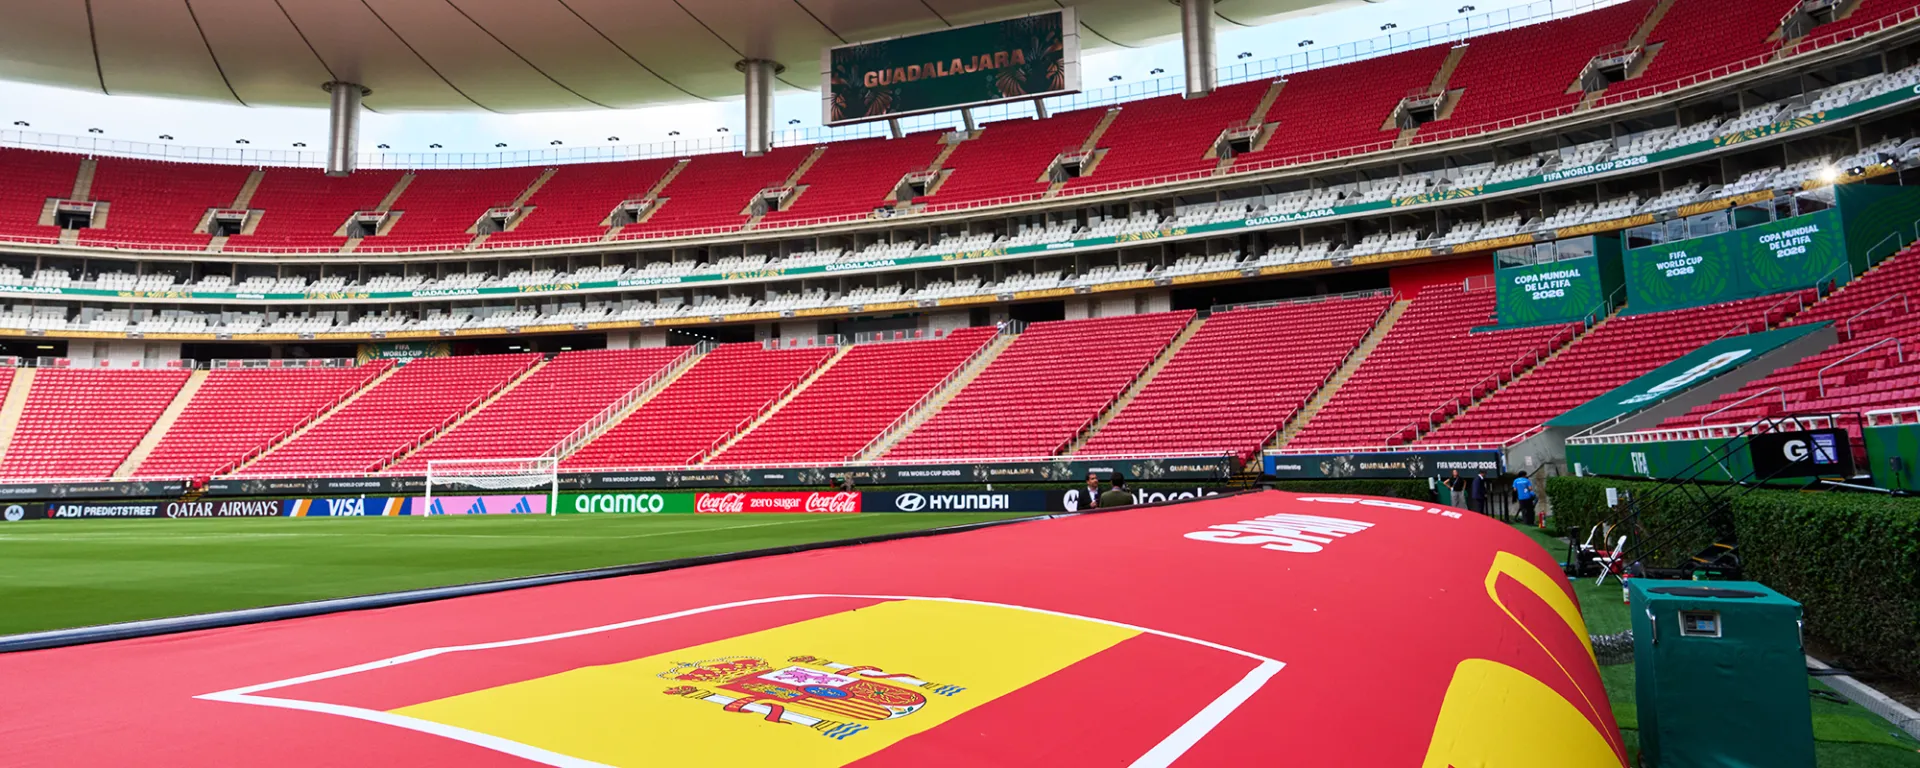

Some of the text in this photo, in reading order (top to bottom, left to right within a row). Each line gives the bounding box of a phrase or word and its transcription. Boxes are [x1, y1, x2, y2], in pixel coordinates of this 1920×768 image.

[863, 48, 1026, 88] GUADALAJARA
[1543, 155, 1648, 181] FIFA WORLD CUP 2026
[1245, 207, 1335, 226] GUADALAJARA
[1759, 224, 1819, 243] COPA MUNDIAL
[1769, 235, 1811, 250] DE LA FIFA
[1669, 251, 1687, 260] FIFA
[1777, 245, 1806, 258] 2026
[825, 258, 896, 272] GUADALAJARA
[1656, 256, 1703, 270] WORLD CUP
[1514, 268, 1581, 285] COPA MUNDIAL
[1666, 266, 1694, 277] 2026
[412, 288, 479, 297] GUADALAJARA
[1525, 279, 1571, 292] DE LA FIFA
[1532, 288, 1565, 300] 2026
[1783, 440, 1809, 462] G
[1436, 461, 1449, 469] FIFA
[1449, 461, 1468, 469] WORLD
[1468, 461, 1479, 469] CUP
[1631, 452, 1648, 475] FIFA
[326, 498, 365, 516] VISA
[575, 494, 664, 513] aramco
[750, 497, 772, 508] zero
[773, 497, 801, 510] sugar
[929, 494, 1009, 509] HYUNDAI
[56, 506, 158, 518] ADI PREDICTSTREET
[166, 500, 279, 519] QATAR AIRWAYS
[1183, 513, 1376, 553] SPAIN
